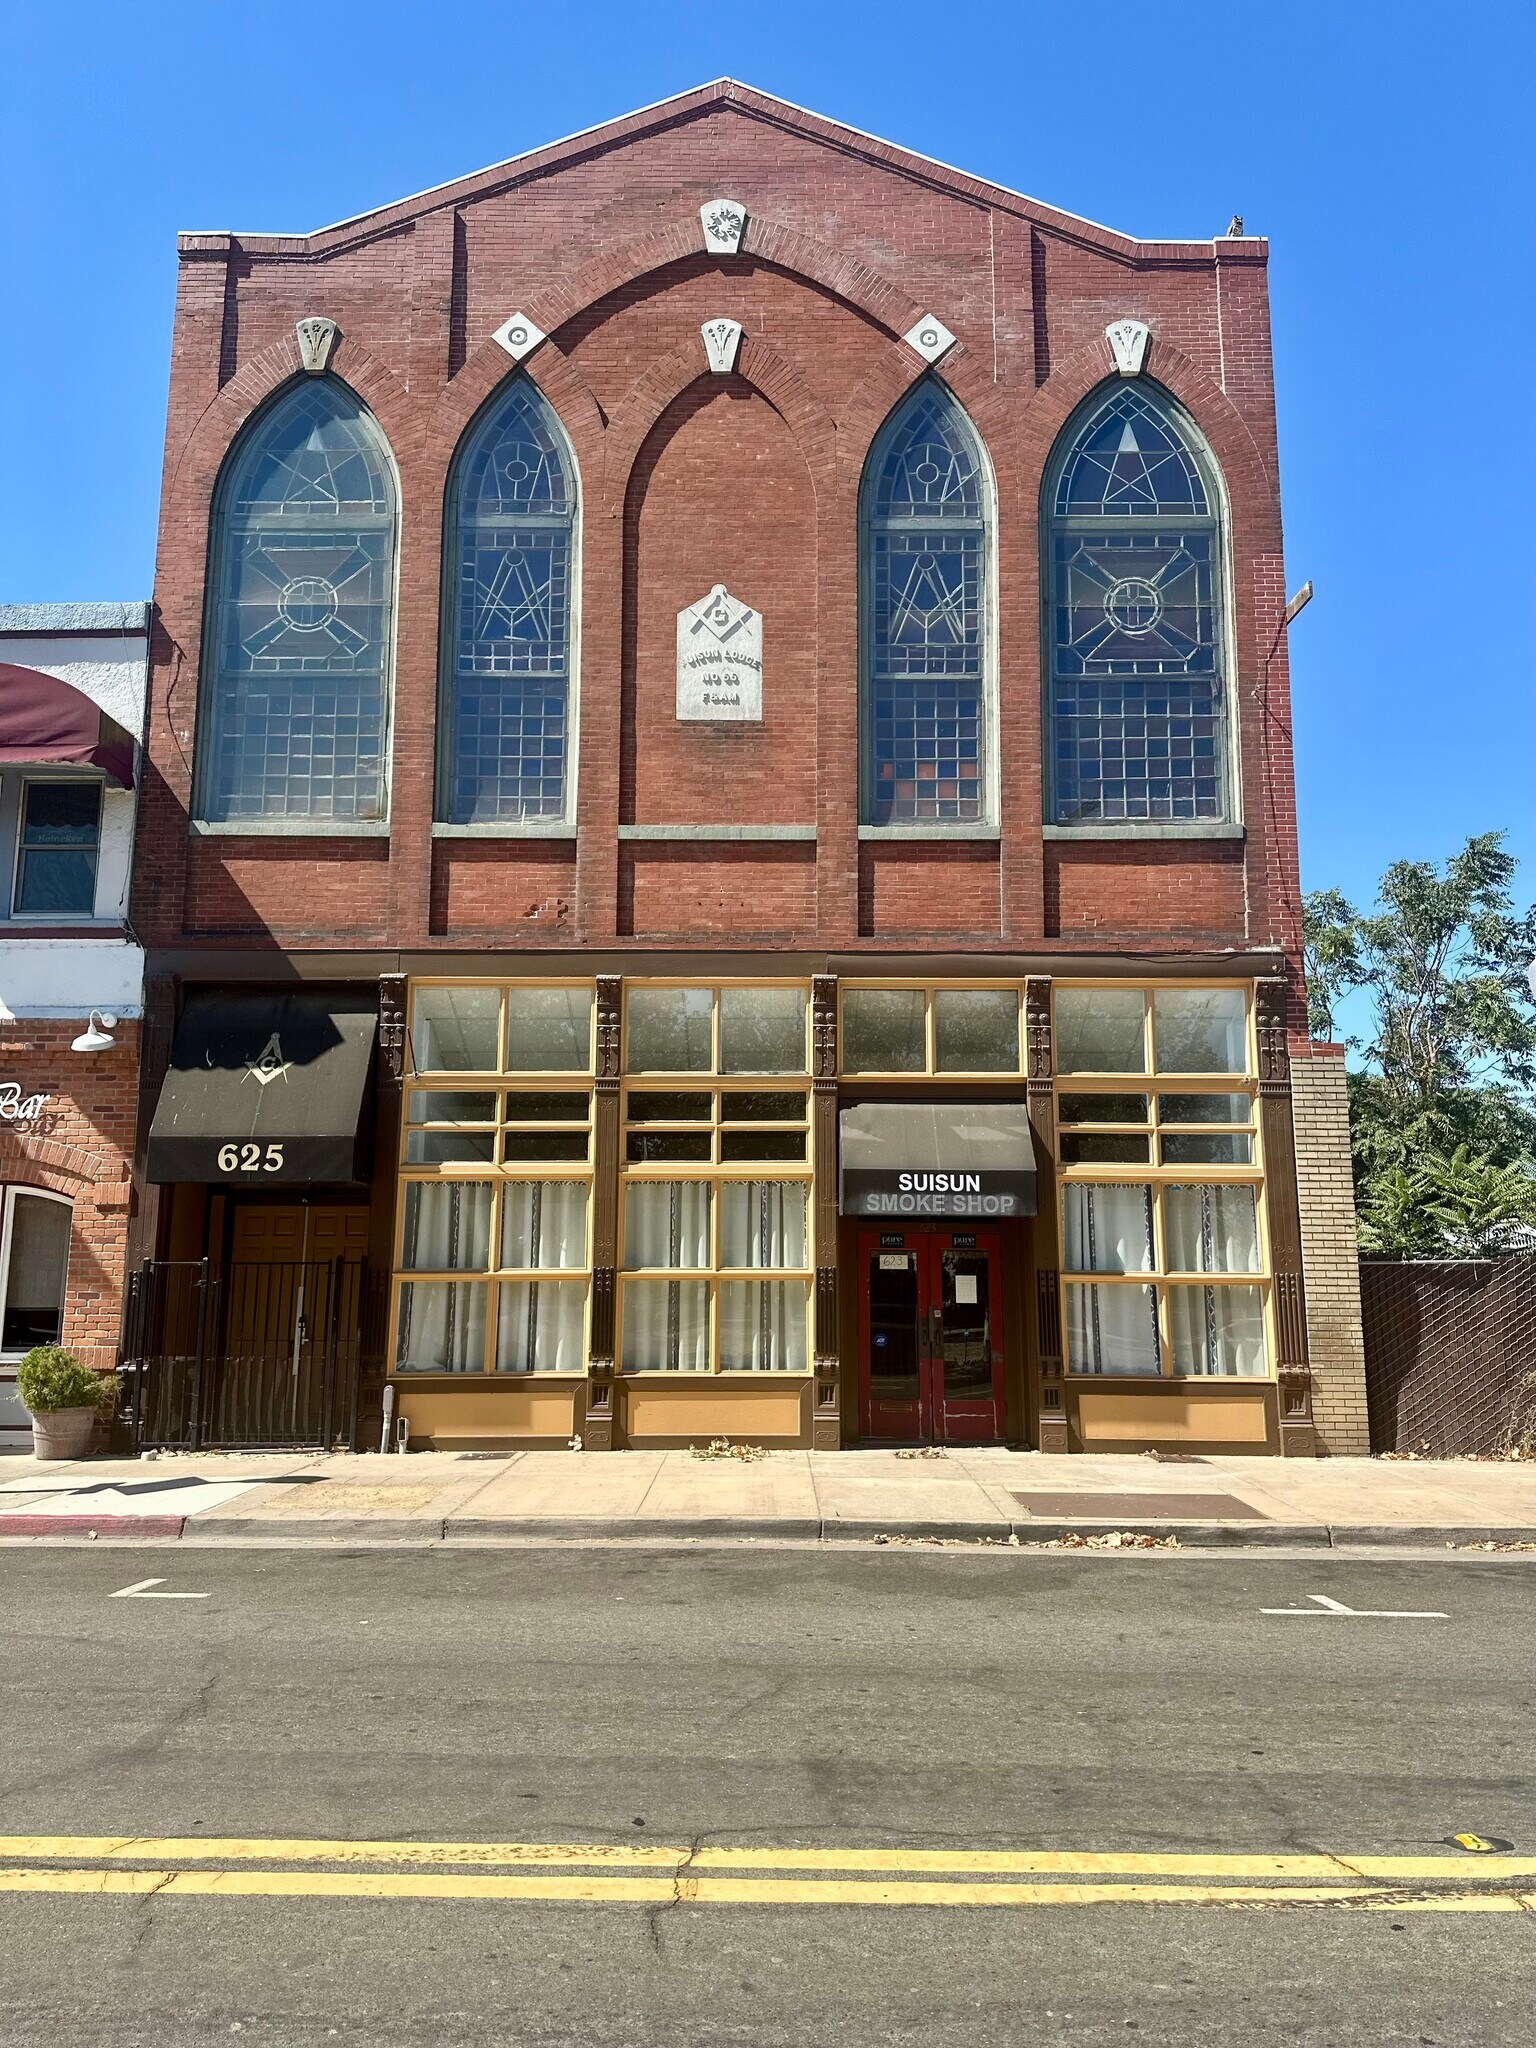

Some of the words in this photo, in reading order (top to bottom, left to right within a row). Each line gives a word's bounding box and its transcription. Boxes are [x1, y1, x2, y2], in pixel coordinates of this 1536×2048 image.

[725, 650, 762, 671] LODGE
[0, 1082, 51, 1119] Bar
[217, 1143, 284, 1172] 625
[898, 1173, 981, 1192] SUISUN
[866, 1193, 946, 1212] SMOKE
[952, 1194, 1014, 1213] SHOP
[883, 1255, 903, 1267] 623
